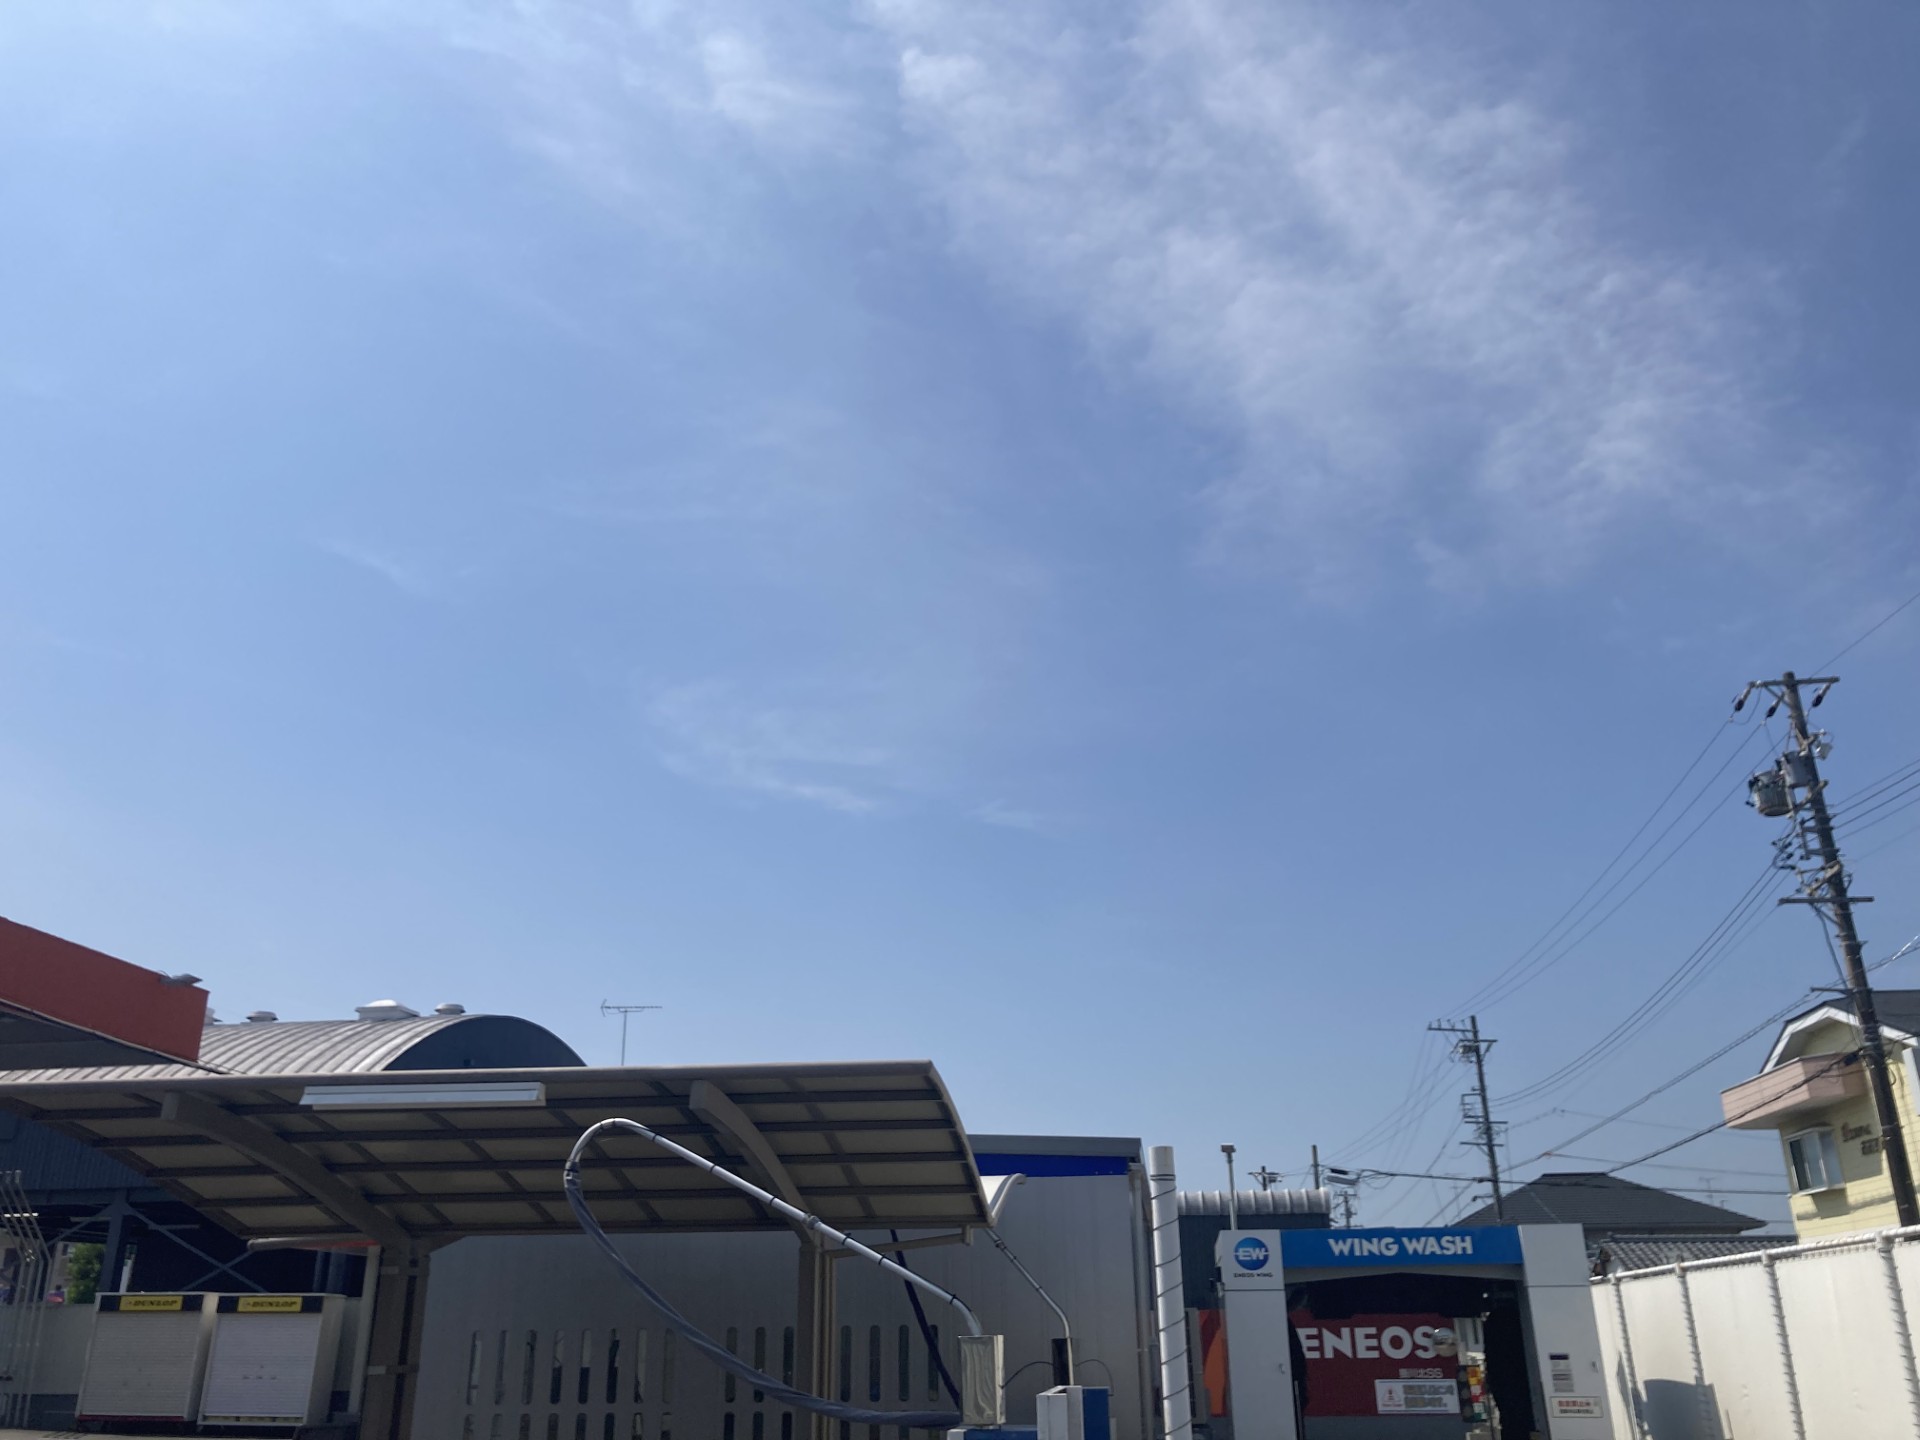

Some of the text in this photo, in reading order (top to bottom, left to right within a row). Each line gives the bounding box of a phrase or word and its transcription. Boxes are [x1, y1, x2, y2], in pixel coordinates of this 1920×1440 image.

[1328, 1236, 1474, 1256] WING WASH
[1239, 1247, 1266, 1261] EW
[133, 1299, 178, 1307] DUNLOP
[252, 1300, 297, 1308] DUNLOP
[1296, 1325, 1436, 1359] ENEOS
